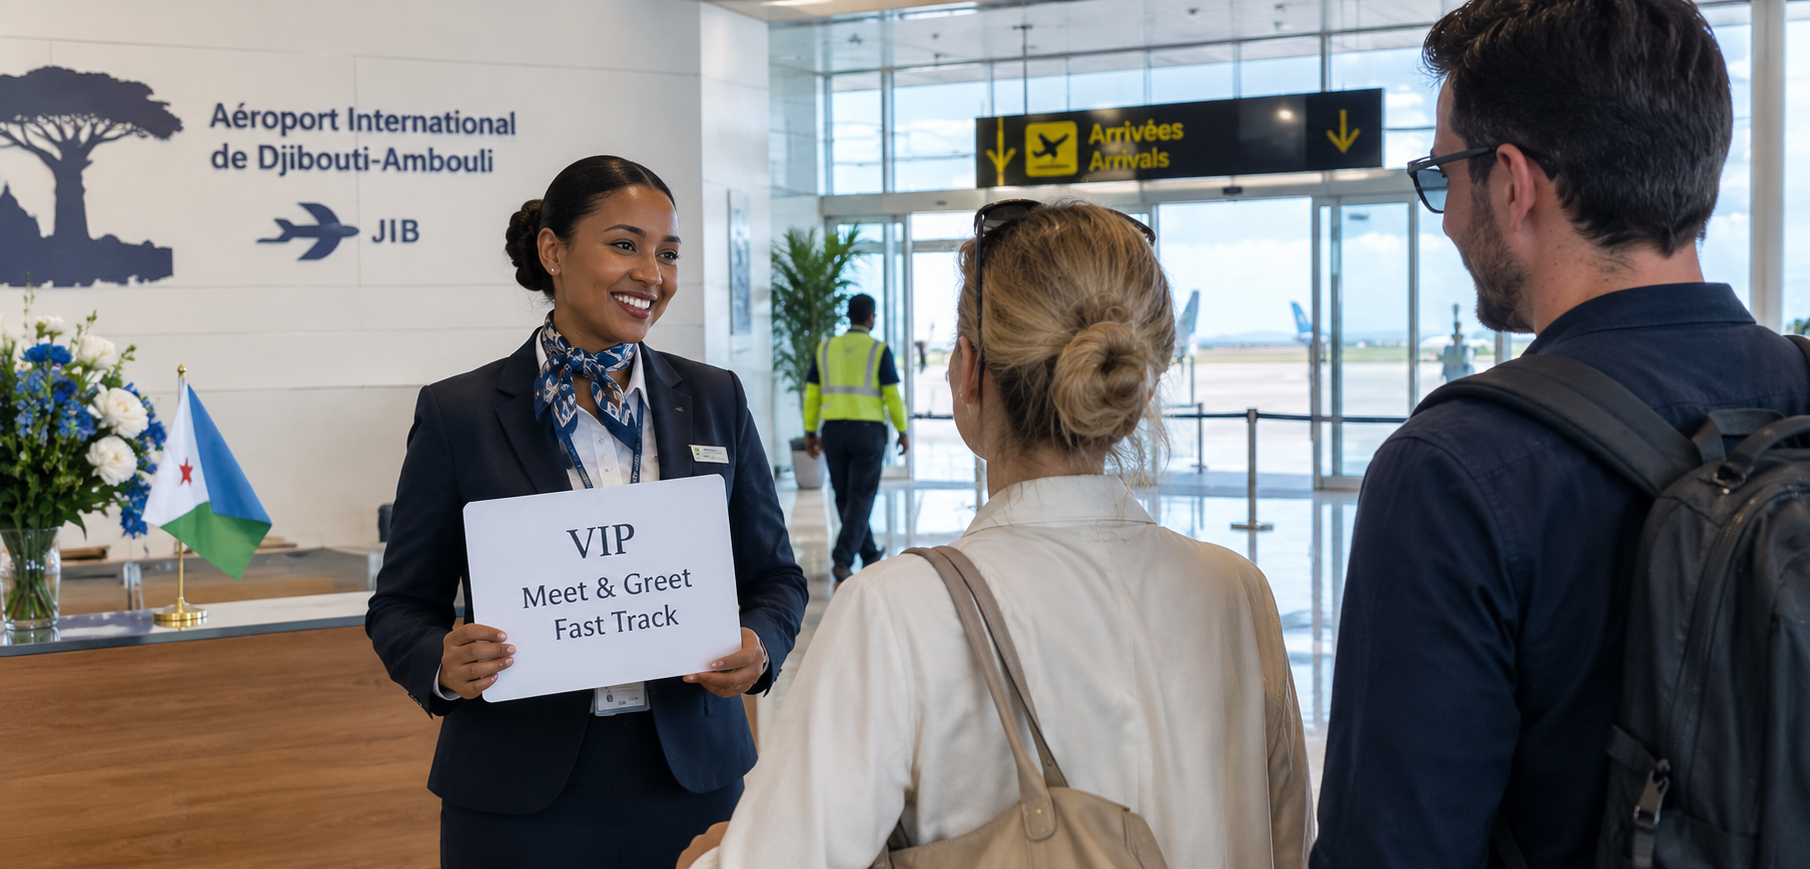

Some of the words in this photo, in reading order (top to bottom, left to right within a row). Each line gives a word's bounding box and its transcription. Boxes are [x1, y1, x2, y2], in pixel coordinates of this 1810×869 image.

[209, 102, 340, 137] Aéroport
[348, 106, 516, 136] International
[1088, 118, 1184, 145] Arrivées
[210, 143, 248, 170] de
[258, 144, 494, 177] Djibouti-Ambouli
[1088, 146, 1170, 172] Arrivals
[371, 218, 420, 244] JIB
[566, 523, 635, 559] VIP
[521, 582, 588, 609] Meet
[596, 576, 617, 601] &
[623, 568, 693, 597] Greet
[554, 615, 606, 642] Fast
[611, 604, 679, 633] Track
